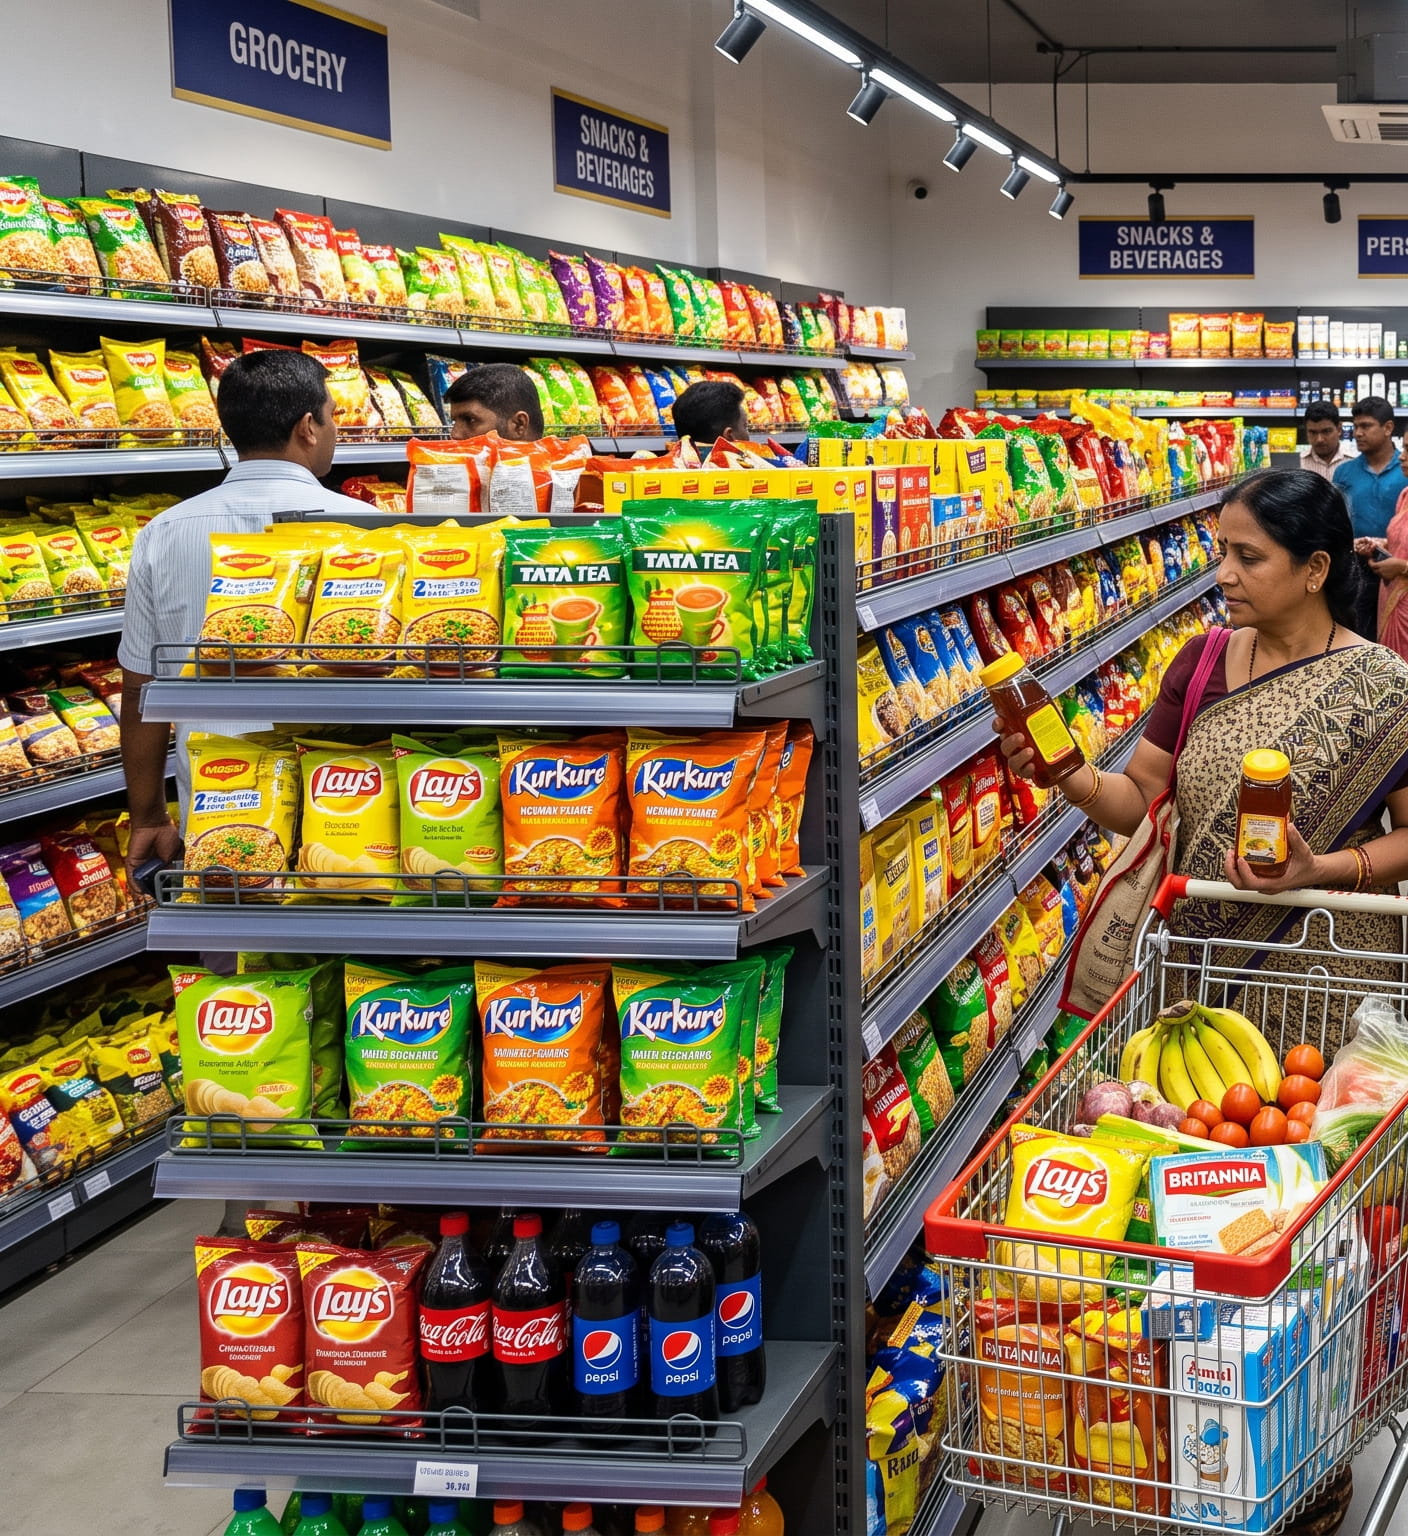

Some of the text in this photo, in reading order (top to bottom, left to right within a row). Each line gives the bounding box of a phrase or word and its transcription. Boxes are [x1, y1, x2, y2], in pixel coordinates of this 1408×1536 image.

[229, 21, 347, 93] GROCERY
[580, 114, 649, 163] SNACKS &
[576, 150, 655, 198] BEVERAGES
[1116, 225, 1215, 246] SNACKS &
[1109, 249, 1224, 270] BEVERAGES
[520, 565, 611, 582] TATA TEA
[644, 552, 740, 570] TATA TEA
[315, 764, 378, 800] Lay's
[414, 768, 478, 807] Lay's
[515, 758, 606, 798] Kurkure
[641, 757, 733, 798] Kurkure
[358, 998, 452, 1042] Kurkure
[488, 997, 582, 1039] Kurkure
[629, 998, 725, 1042] Kurkure
[1028, 1159, 1107, 1209] Lay's
[1168, 1167, 1262, 1188] BRITANNIA
[213, 1279, 286, 1318] Lay's
[317, 1283, 389, 1323] Lay's
